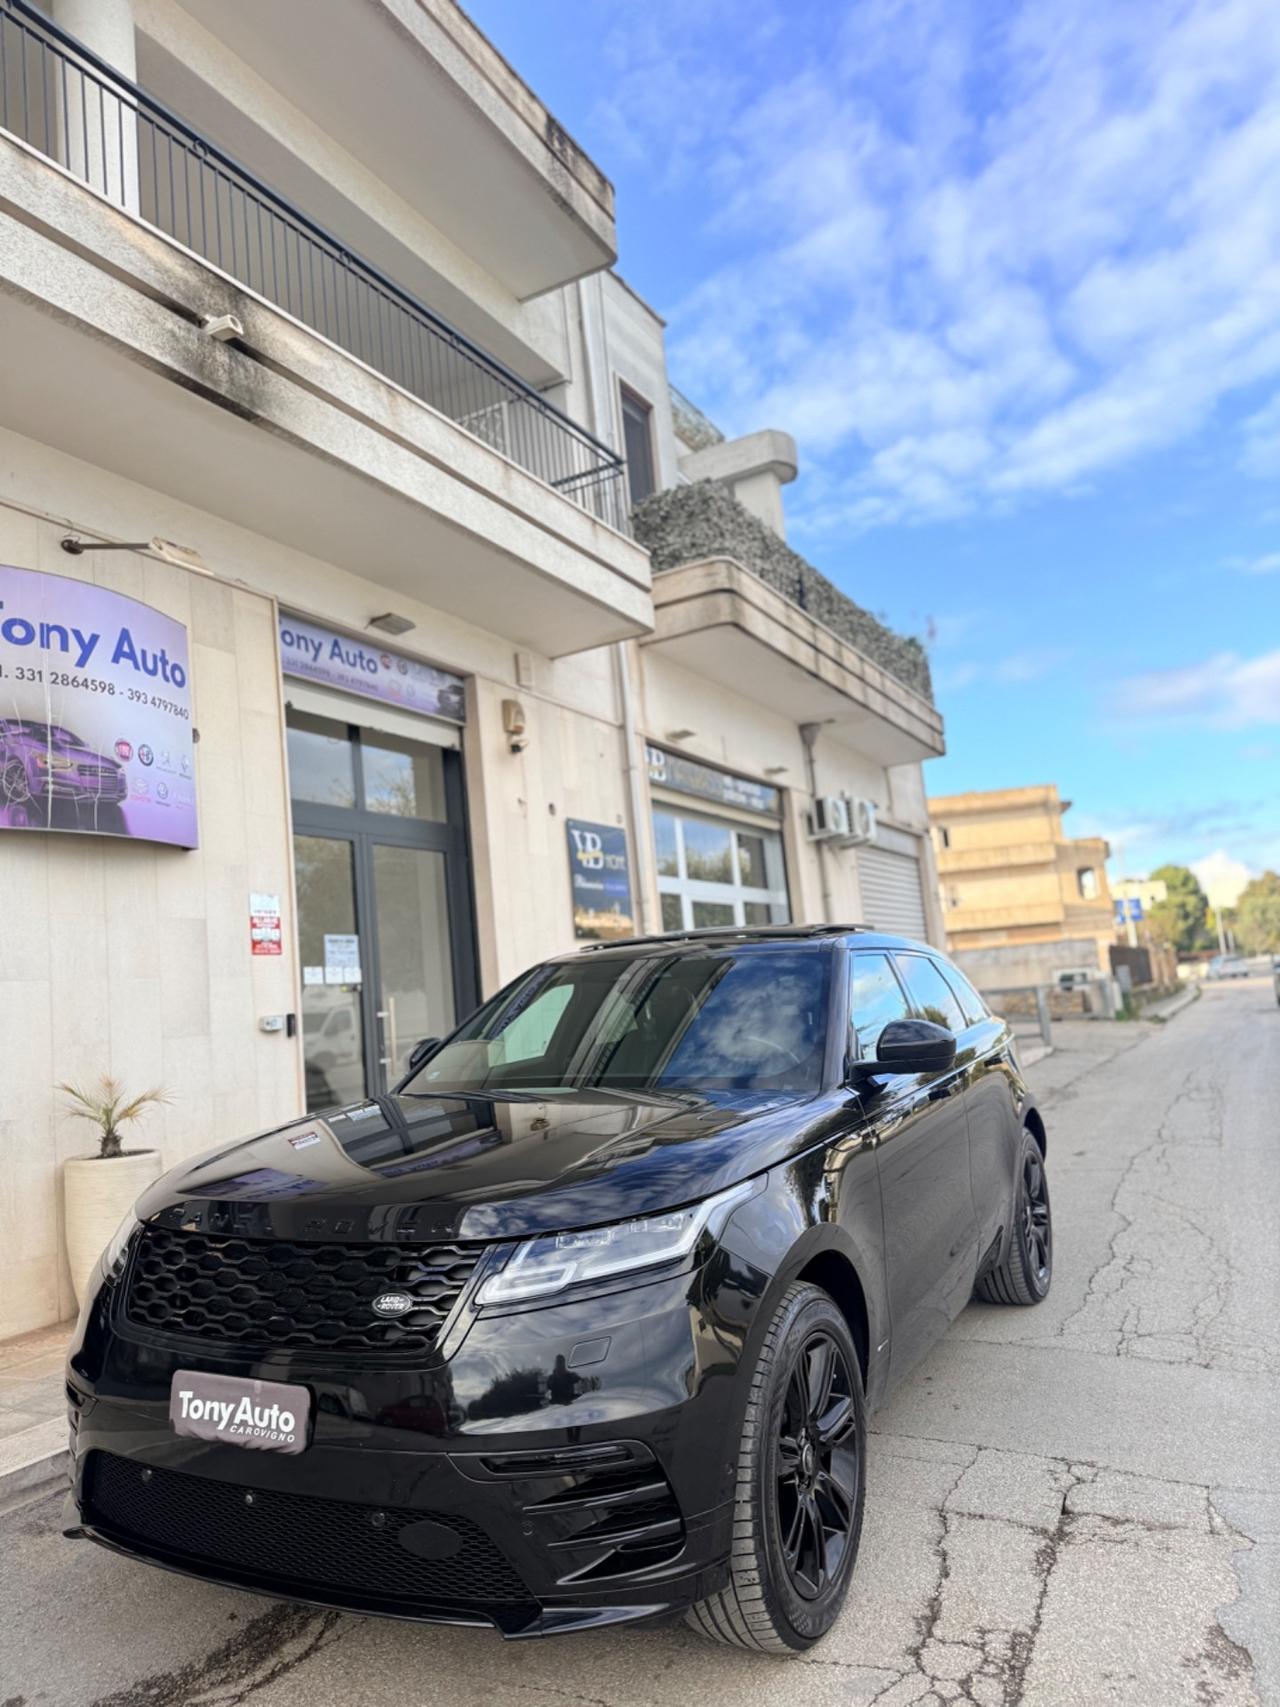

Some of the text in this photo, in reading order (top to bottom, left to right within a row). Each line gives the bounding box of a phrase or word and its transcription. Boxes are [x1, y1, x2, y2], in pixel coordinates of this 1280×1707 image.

[0, 601, 186, 688] ony Auto
[279, 619, 322, 662] ony
[329, 638, 378, 674] Auto
[15, 666, 43, 682] 331
[49, 671, 115, 696] 2864598
[128, 687, 148, 705] 393
[150, 696, 189, 720] 4797840
[229, 1425, 295, 1443] CAROVIGNO
